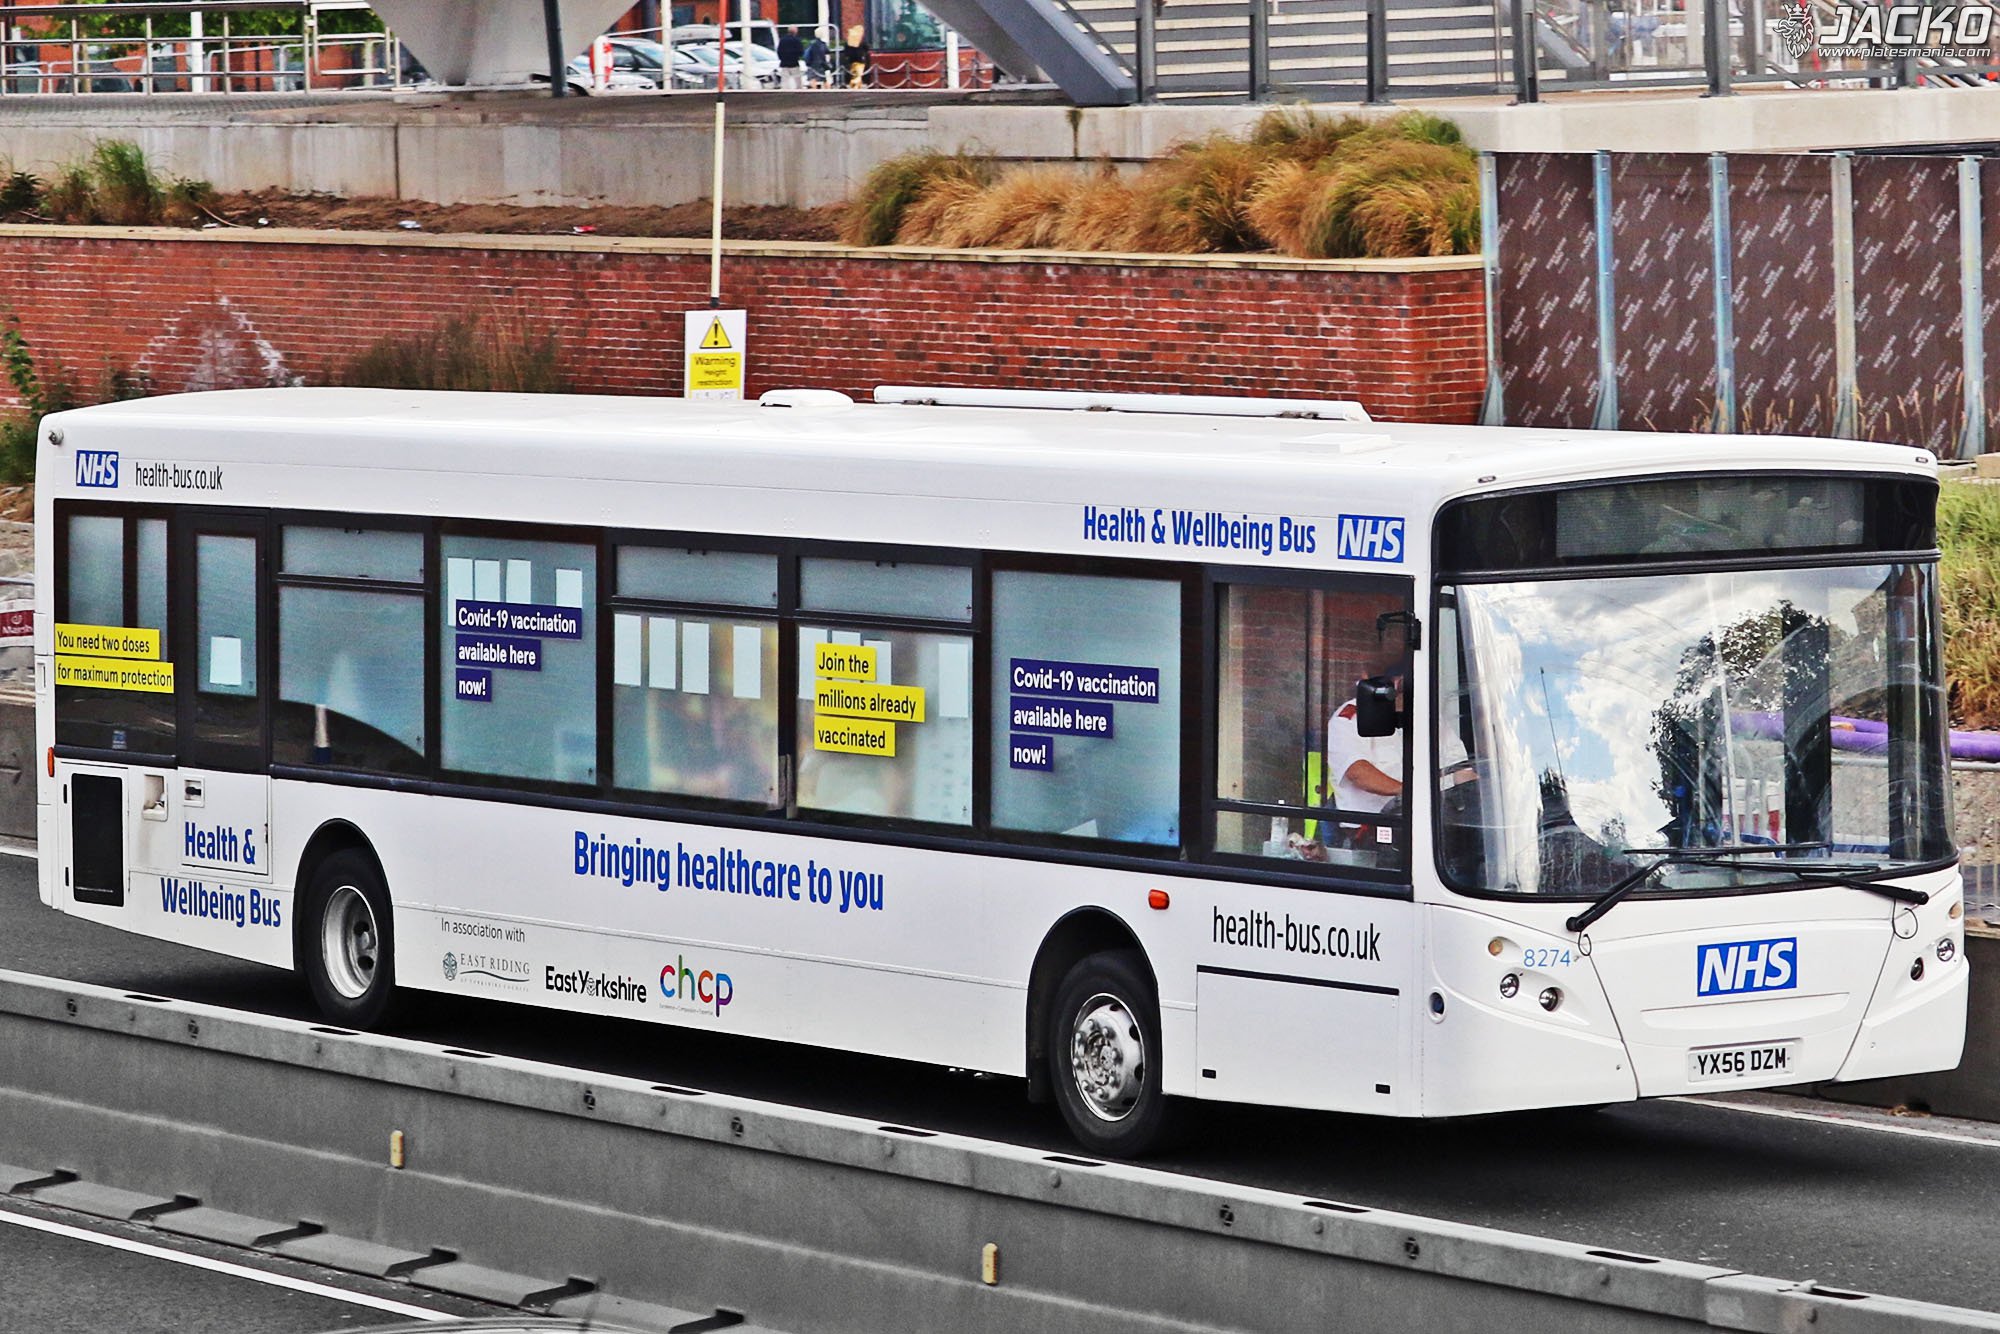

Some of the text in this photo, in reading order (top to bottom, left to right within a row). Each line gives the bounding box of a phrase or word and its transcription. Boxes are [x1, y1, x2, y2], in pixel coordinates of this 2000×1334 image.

[77, 453, 118, 486] NHS
[135, 462, 223, 490] health-bus.co.uk
[1084, 506, 1316, 556] Health & Wellbeing Bus
[1339, 517, 1402, 560] NHS
[458, 607, 577, 633] Covid-19 vaccination
[57, 632, 150, 653] You need two doses
[458, 642, 536, 665] available here
[57, 663, 172, 687] for maximum protection
[818, 652, 869, 674] Join the
[458, 677, 486, 696] now!
[1013, 666, 1156, 697] Covid-19 vaccination
[818, 689, 916, 720] millions already
[1013, 706, 1107, 732] available here
[818, 727, 886, 749] vaccinated
[1013, 745, 1046, 765] now!
[185, 821, 256, 865] Health &
[574, 830, 884, 913] Bringing healthcare to you
[160, 877, 281, 928] Wellbeing Bus
[441, 918, 526, 943] In association with
[1213, 905, 1381, 961] health-bus.co.uk
[460, 953, 530, 975] EAST RIDING
[1523, 949, 1571, 968] 8274
[1700, 941, 1794, 993] NHS
[660, 954, 734, 1018] chcp
[1697, 1047, 1786, 1075] YX56 DZM
